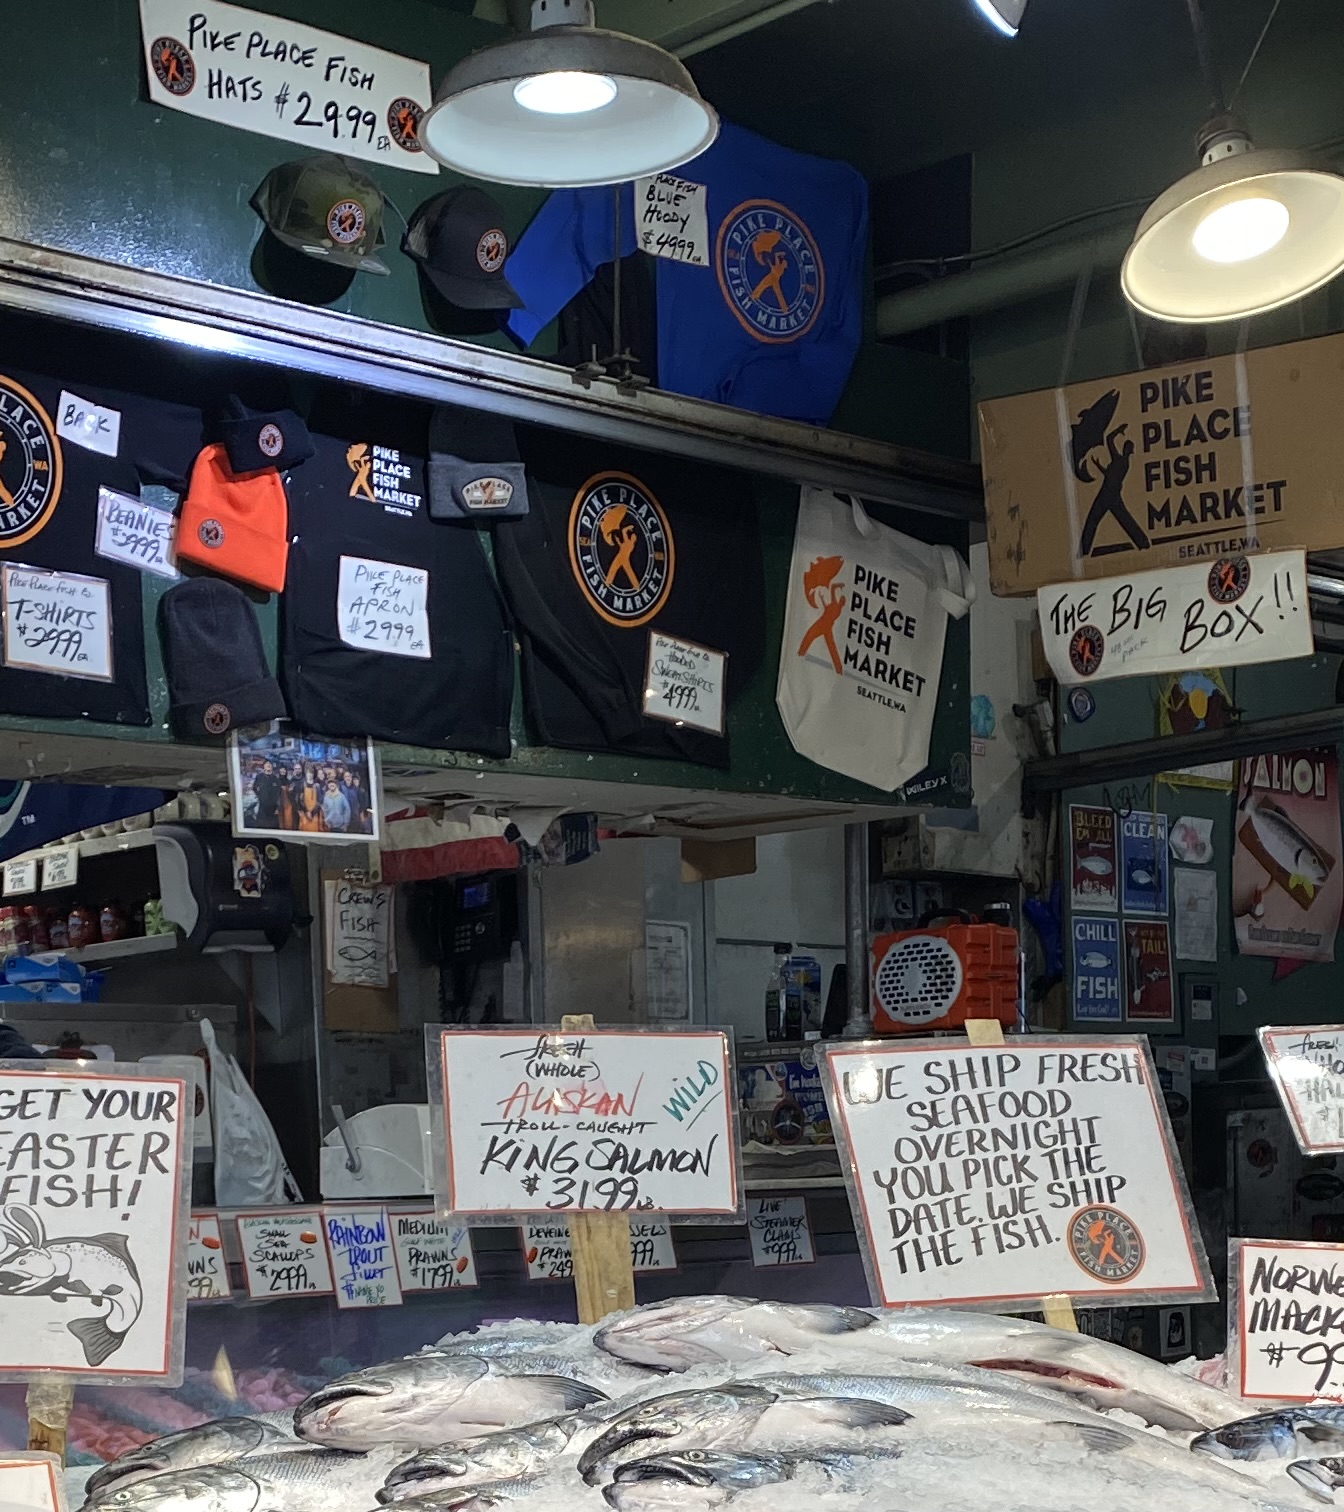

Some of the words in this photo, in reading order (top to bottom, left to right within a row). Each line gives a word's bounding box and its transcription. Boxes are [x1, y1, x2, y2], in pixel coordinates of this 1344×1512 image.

[188, 13, 242, 51] PIKE
[245, 32, 318, 68] PLACE
[324, 56, 375, 91] FISH
[207, 68, 263, 101] HATS
[646, 184, 687, 206] BLUE
[643, 204, 690, 233] HOODY
[732, 214, 767, 244] PIKE
[775, 216, 815, 274] PLACE
[729, 267, 753, 309] FISH
[757, 299, 811, 330] MARKET
[1140, 370, 1215, 413] PIKE
[63, 404, 111, 435] BACK
[1142, 404, 1251, 453] PLACE
[373, 445, 400, 461] PIKE
[373, 459, 411, 479] PLACE
[1144, 452, 1217, 493] FISH
[373, 473, 399, 489] FISH
[373, 487, 421, 508] MARKET
[581, 488, 611, 529] PIKE
[619, 488, 663, 538] PLACE
[1147, 480, 1287, 531] MARKET
[355, 564, 390, 583] PIKE
[393, 569, 424, 584] PLACE
[371, 582, 400, 597] FISH
[582, 555, 606, 599] FISH
[613, 567, 663, 611] MARKET
[854, 564, 899, 602] PIKE
[349, 596, 414, 617] APRON
[850, 591, 916, 638] PLACE
[1051, 593, 1096, 635] THE
[1107, 584, 1166, 636] BIG
[847, 618, 891, 655] FISH
[844, 644, 926, 697] MARKET
[1244, 752, 1327, 798] SALMON
[1075, 810, 1112, 829] BLEED
[1123, 821, 1165, 840] CLEAN
[337, 888, 386, 910] CREWS
[339, 913, 381, 933] FISH
[1075, 922, 1117, 942] CHILL
[1076, 975, 1118, 1000] FISH
[496, 1072, 644, 1119] ALASKAN
[662, 1061, 718, 1122] WILD
[843, 1065, 906, 1105] WE
[923, 1054, 1022, 1094] SHIP
[1038, 1053, 1145, 1086] FRESH
[81, 1088, 176, 1122] YOUR
[907, 1089, 1072, 1132] SEAFOOD
[480, 1134, 579, 1175] KING
[585, 1134, 718, 1177] SALMON
[894, 1116, 1103, 1164] OVERNIGHT
[873, 1165, 951, 1205] YOU
[965, 1153, 1040, 1190] PICK
[1042, 1144, 1107, 1181] THE
[328, 1206, 386, 1249] RAINBOW
[888, 1194, 984, 1240] DATE.
[986, 1184, 1041, 1223] WE
[1046, 1175, 1127, 1209] SHIP
[408, 1247, 457, 1265] PRAWNS
[890, 1229, 963, 1274] THE
[971, 1215, 1061, 1257] FISH.
